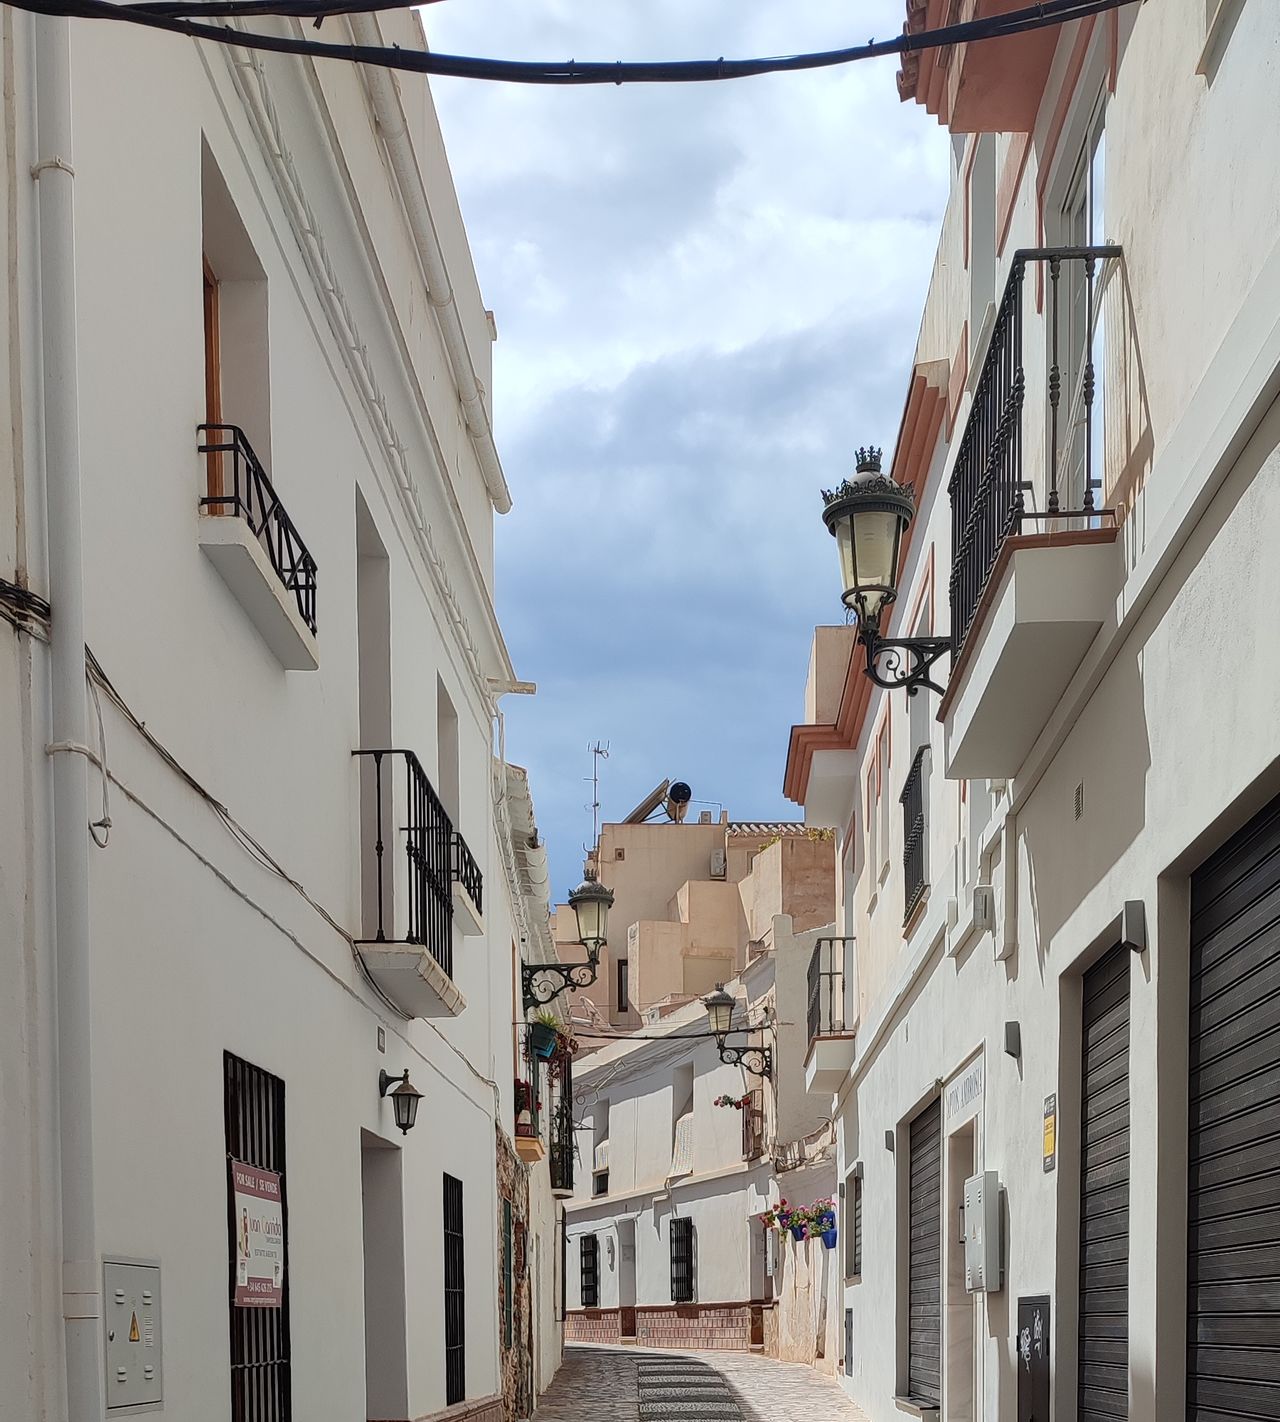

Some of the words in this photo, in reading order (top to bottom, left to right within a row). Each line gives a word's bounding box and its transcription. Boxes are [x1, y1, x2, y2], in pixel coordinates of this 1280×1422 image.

[236, 1172, 245, 1185] FOR
[245, 1174, 255, 1188] SALE
[259, 1179, 265, 1191] SE
[265, 1181, 278, 1194] VENDE
